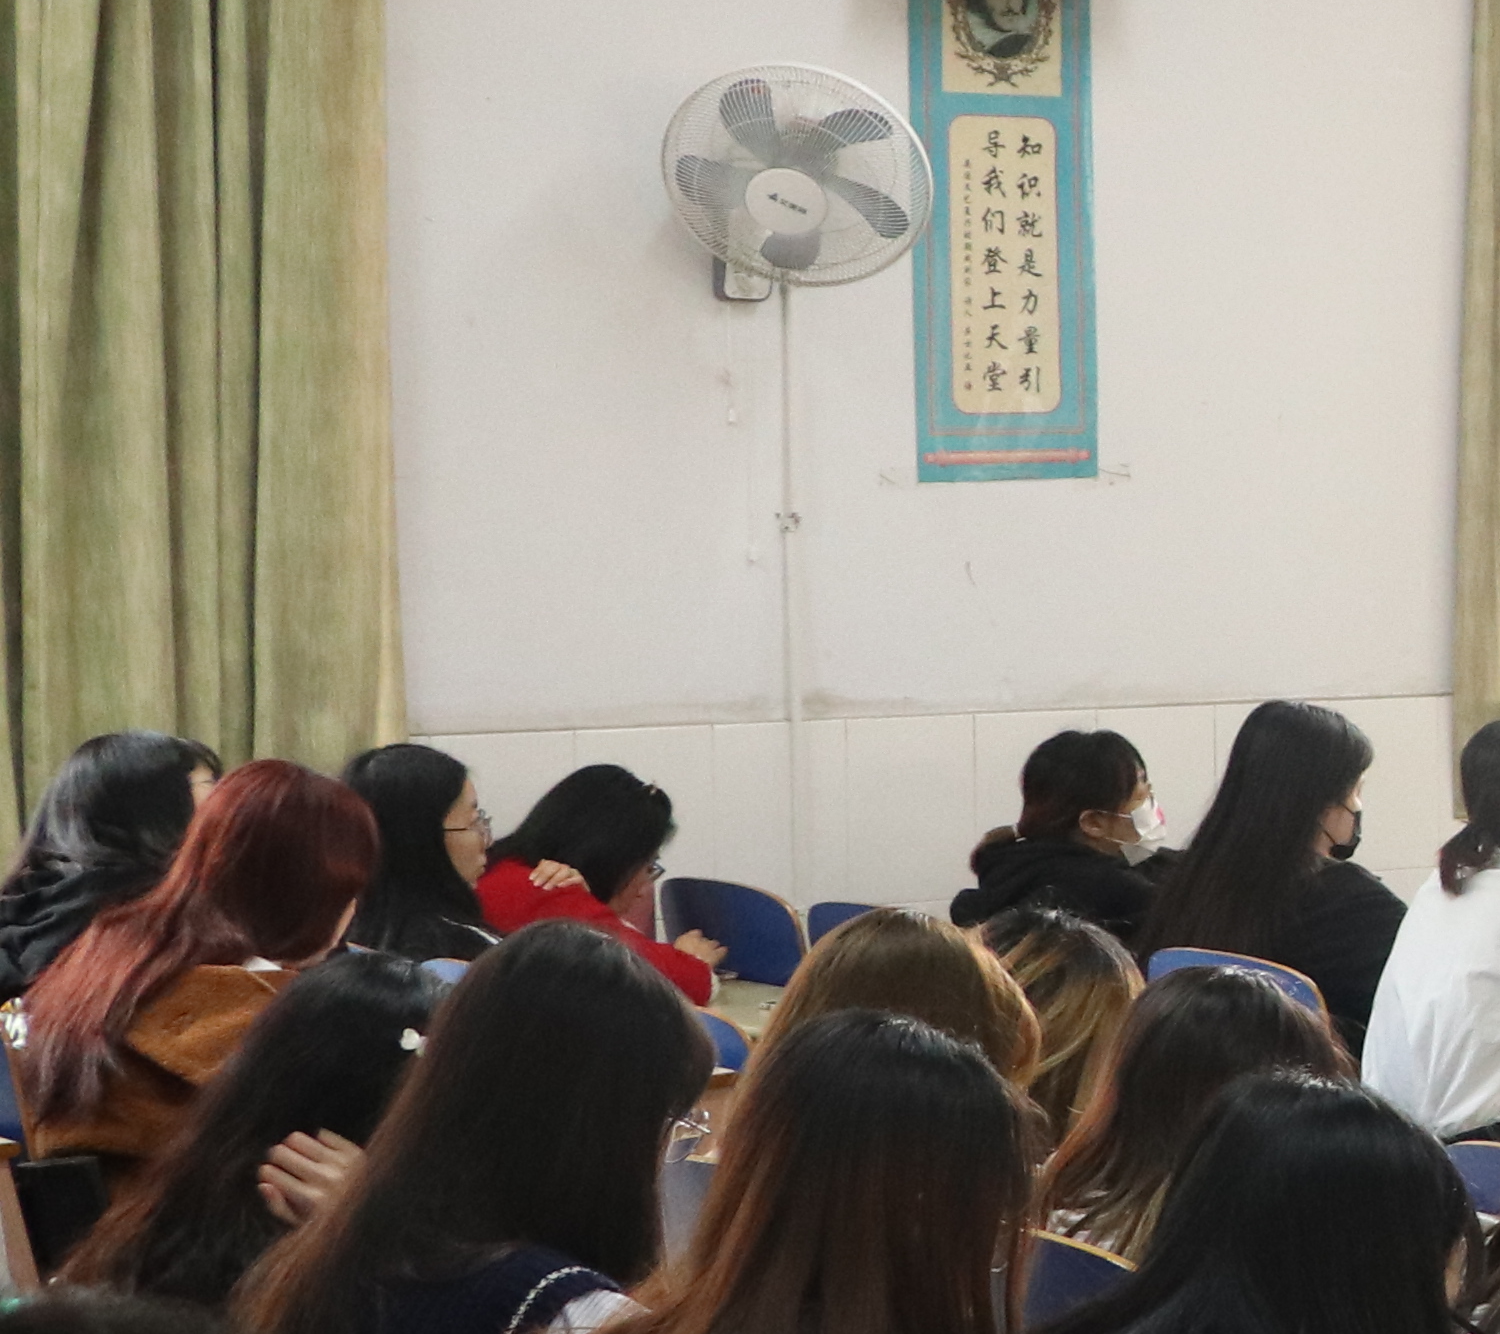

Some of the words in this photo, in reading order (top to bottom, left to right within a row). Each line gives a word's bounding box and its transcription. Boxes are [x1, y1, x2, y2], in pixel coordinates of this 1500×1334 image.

[981, 129, 1008, 392] 导我们登上天堂
[1016, 133, 1043, 393] 知识就是力量引
